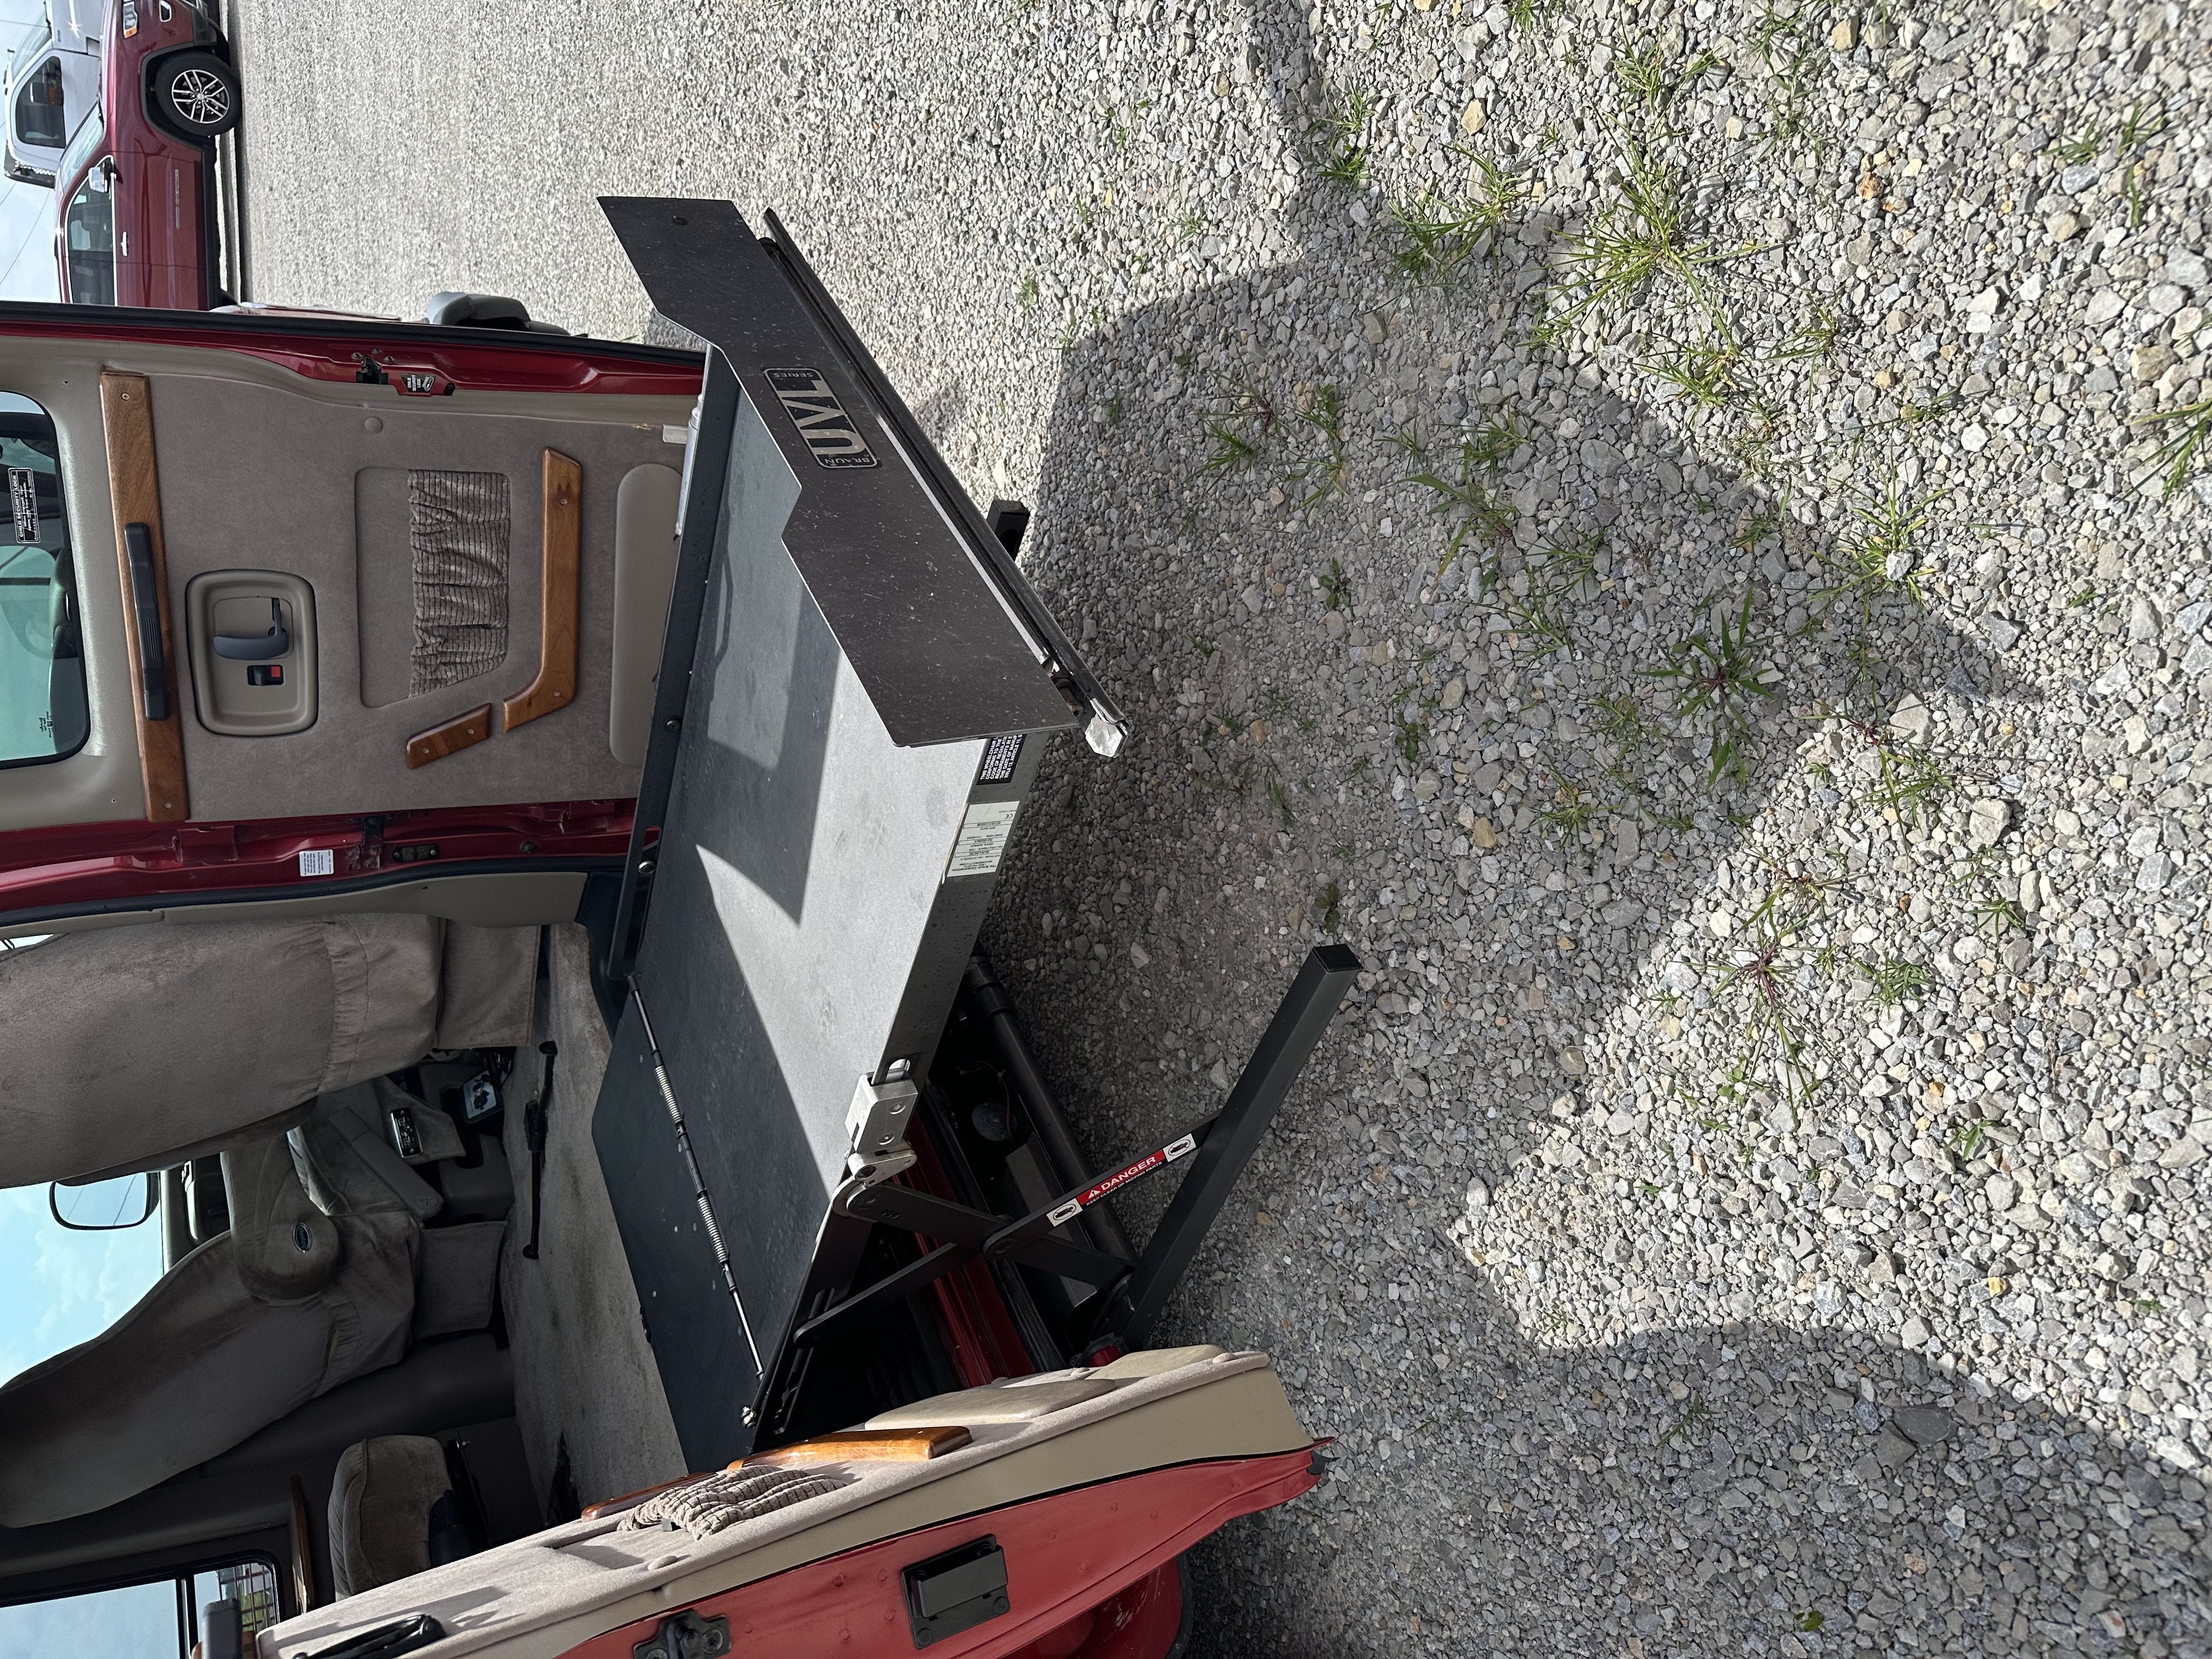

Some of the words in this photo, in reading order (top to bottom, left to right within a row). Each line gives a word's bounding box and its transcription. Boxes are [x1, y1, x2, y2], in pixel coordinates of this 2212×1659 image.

[776, 380, 866, 455] UVL
[984, 740, 996, 769] WHEELCHAIR
[985, 754, 996, 779] CONFORMS
[1086, 1197, 1099, 1205] KEEP
[1101, 1187, 1118, 1198] CLEAR
[1126, 1171, 1145, 1183] MOVING
[1146, 1161, 1162, 1171] PARTS
[1101, 1156, 1156, 1190] DANGER
